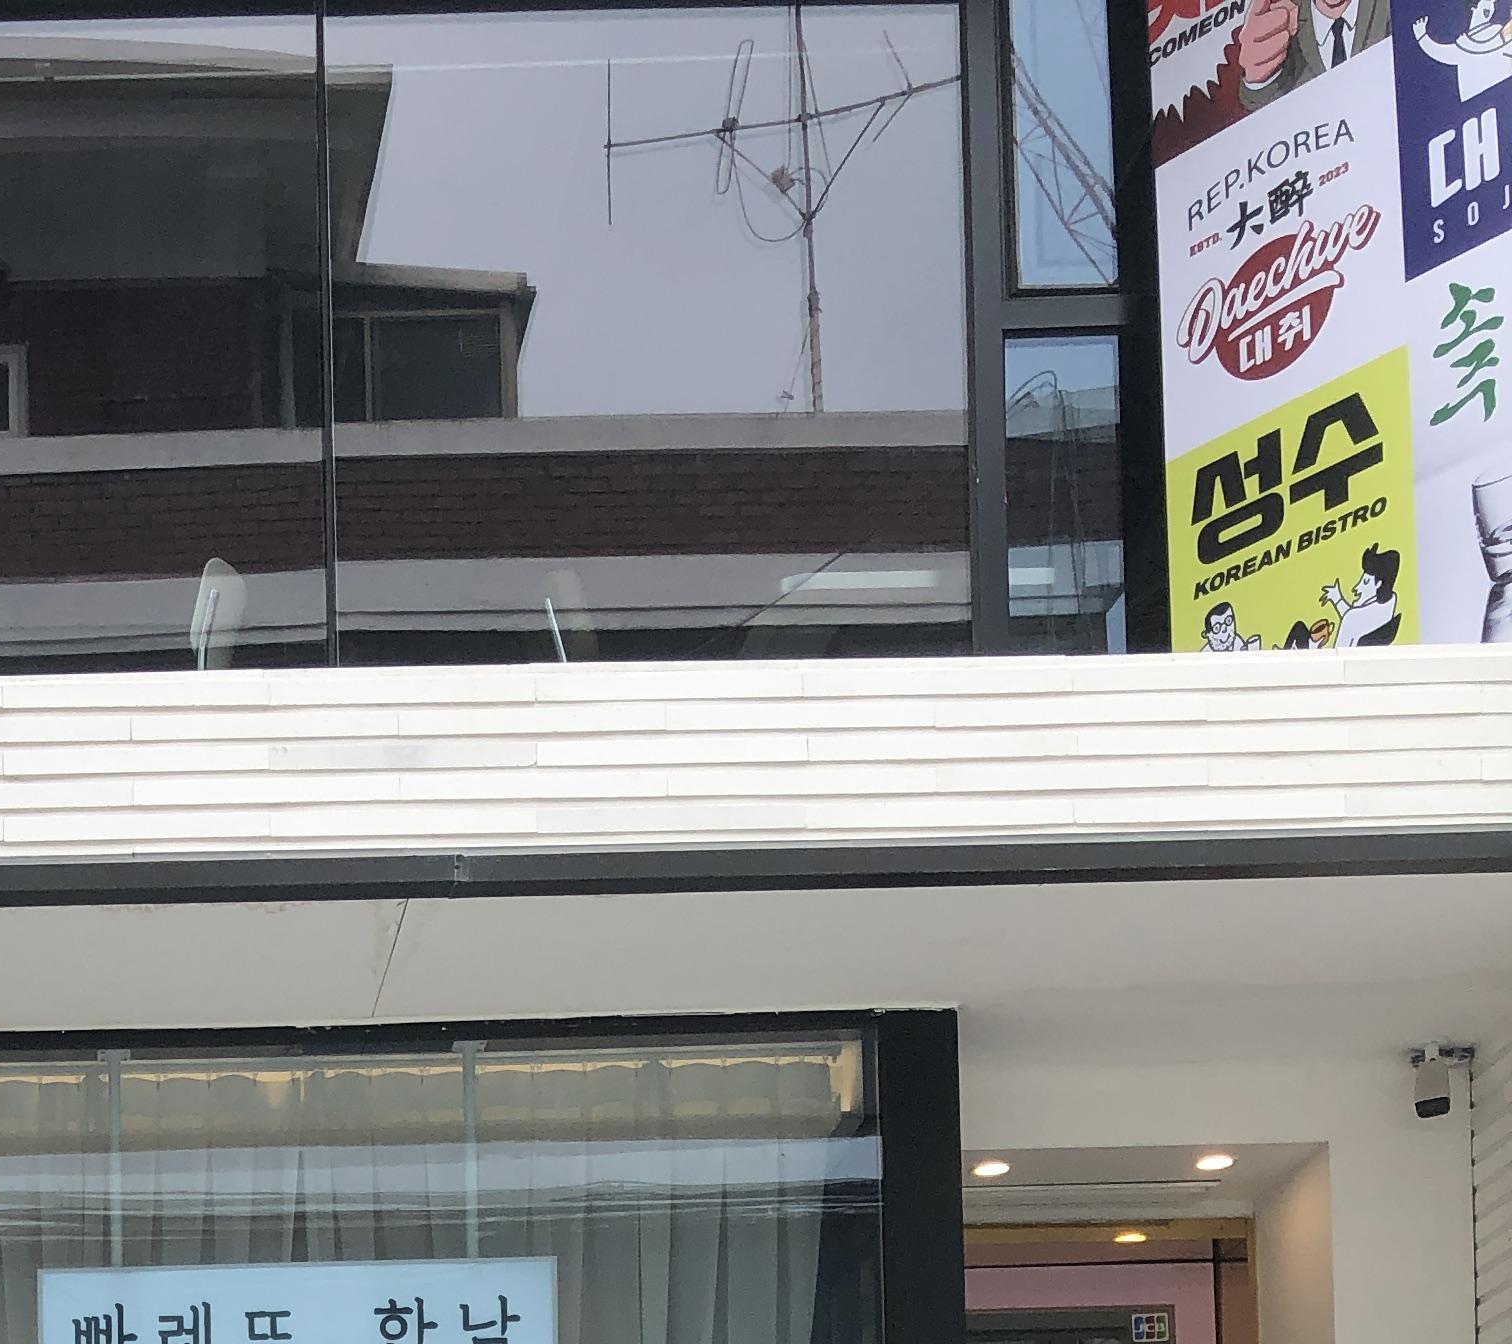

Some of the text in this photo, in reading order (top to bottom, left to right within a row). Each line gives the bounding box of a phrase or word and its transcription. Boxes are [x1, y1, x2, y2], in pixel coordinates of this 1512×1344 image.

[1188, 119, 1355, 231] REP.KOREA
[1318, 162, 1349, 186] 2023
[1176, 204, 1381, 364] Daechwe
[1239, 303, 1311, 373] 대취
[1190, 392, 1384, 565] 성수
[1193, 496, 1388, 601] KOREAN BISTRO
